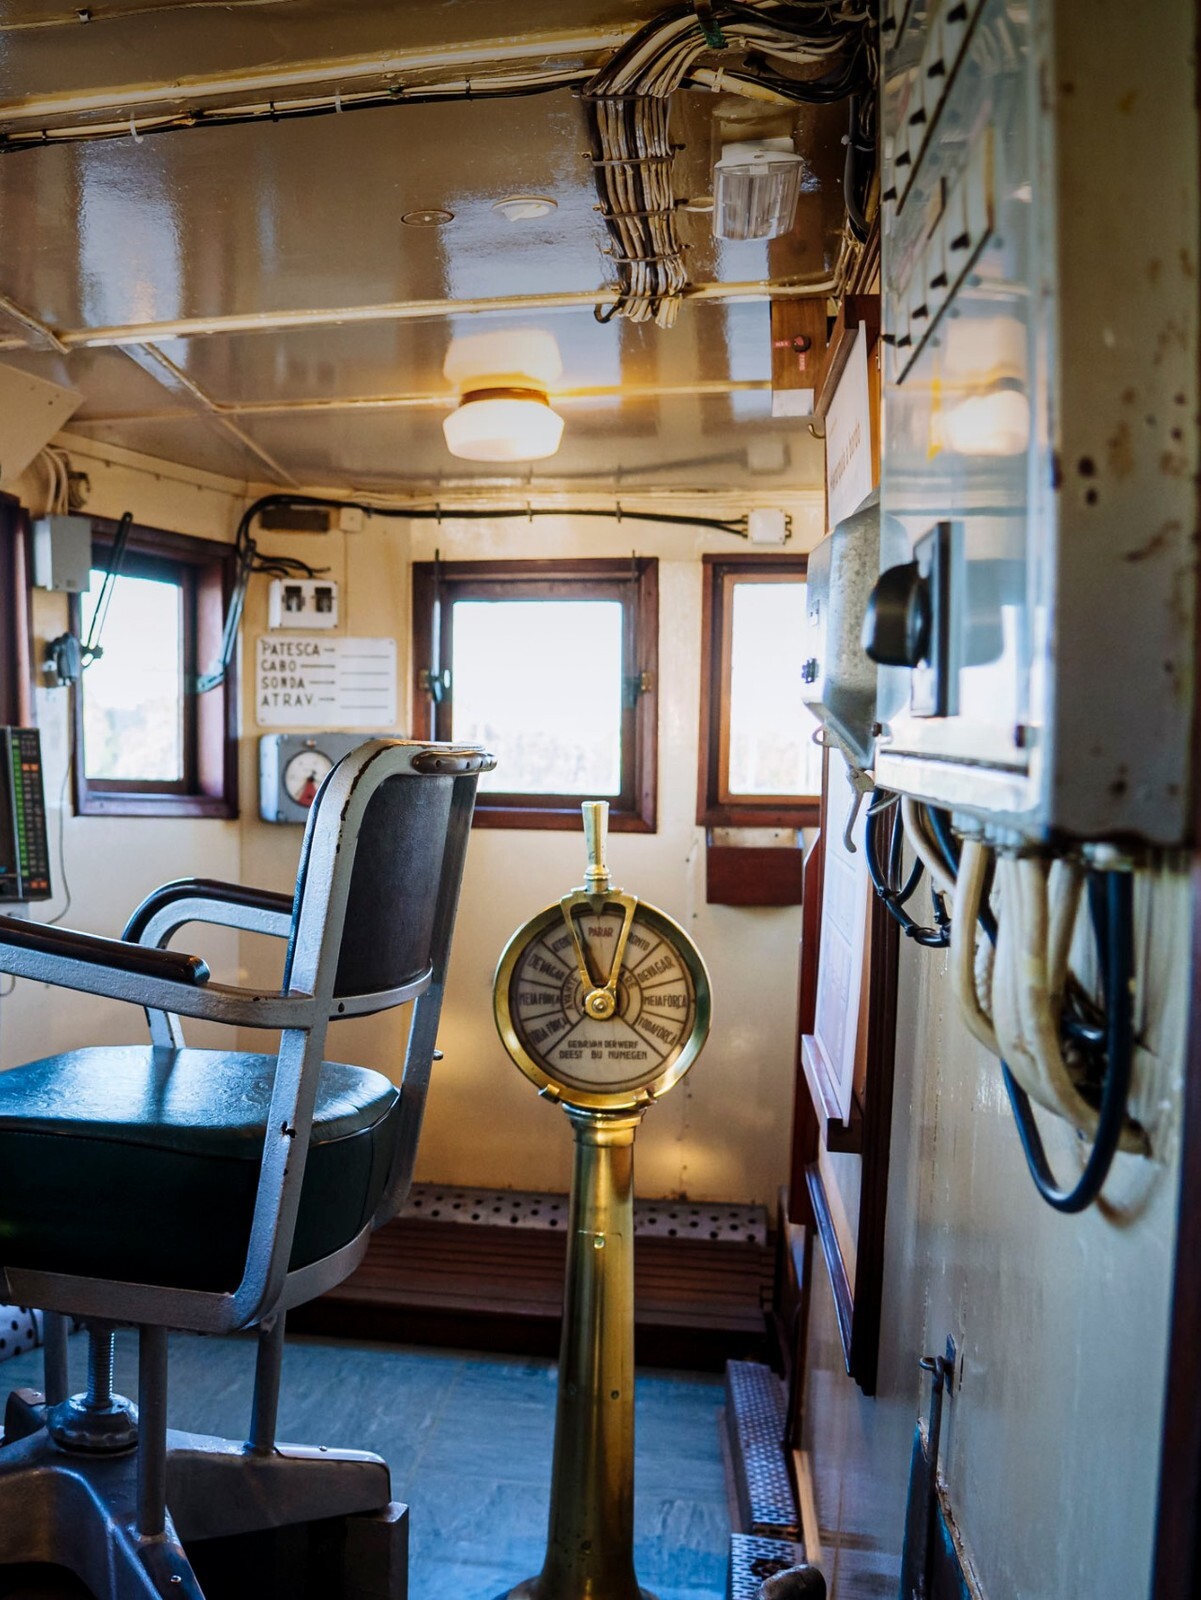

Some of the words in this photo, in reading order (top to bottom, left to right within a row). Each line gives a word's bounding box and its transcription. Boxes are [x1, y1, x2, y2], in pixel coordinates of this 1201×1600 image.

[261, 641, 320, 656] PATESCA
[261, 659, 297, 672] CABO
[261, 676, 305, 689] SONDA
[588, 926, 614, 937] PARAR
[527, 953, 566, 981] DEVAGAR
[637, 956, 676, 983] DEVAGAR
[559, 1050, 583, 1059] DEEST
